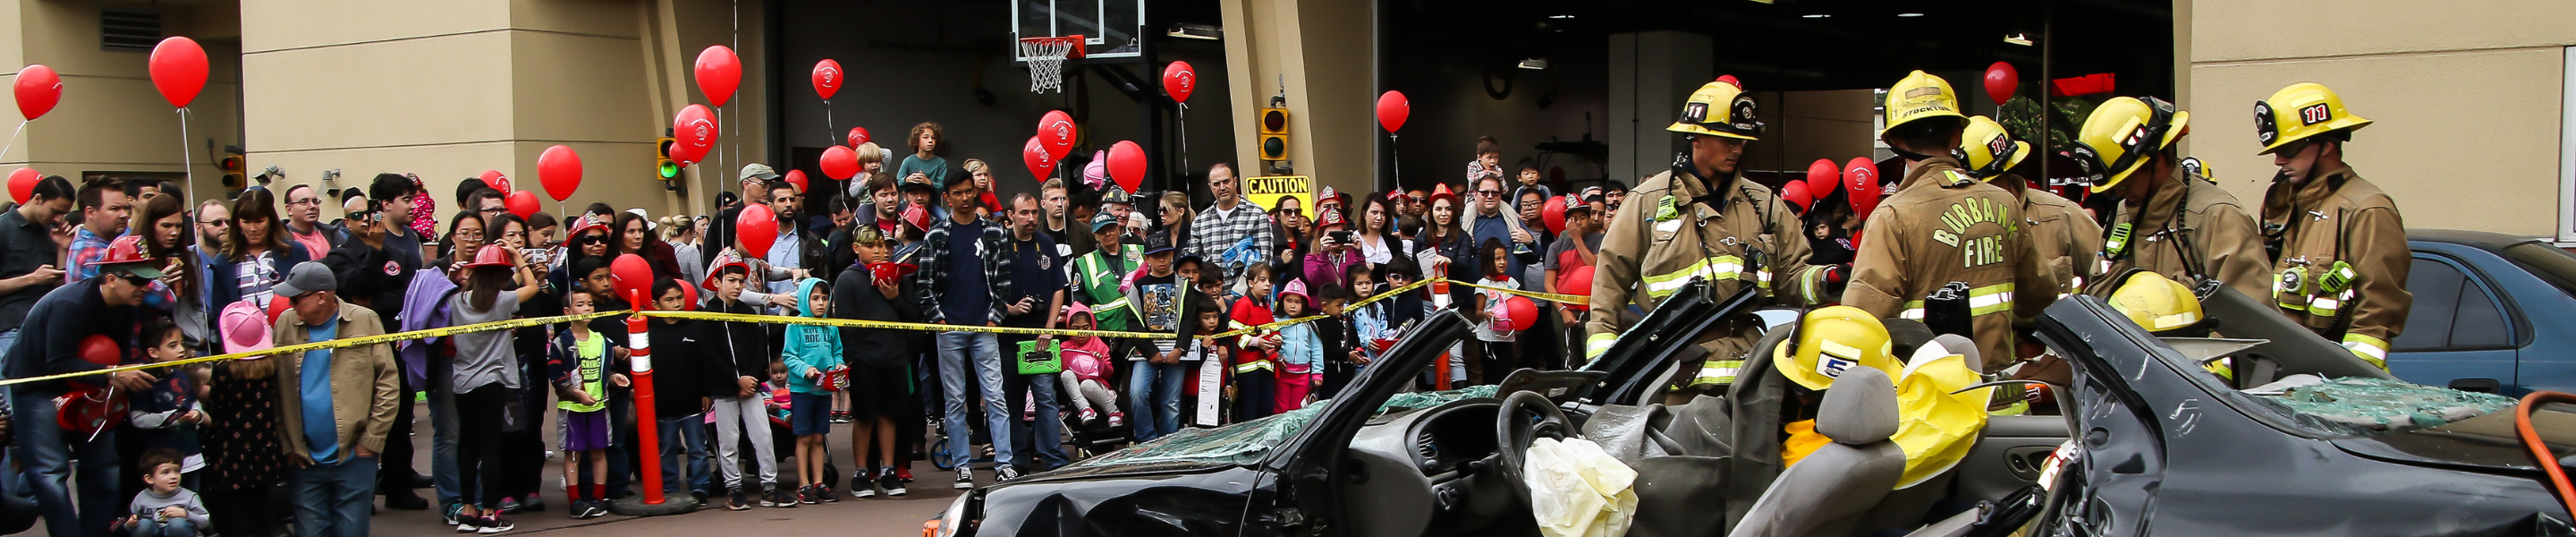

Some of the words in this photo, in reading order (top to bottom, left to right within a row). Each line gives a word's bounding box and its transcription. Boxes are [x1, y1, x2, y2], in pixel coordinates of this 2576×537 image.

[1688, 105, 1703, 119] 11
[1902, 106, 1952, 118] STOCKTON
[2304, 105, 2327, 124] 11
[1991, 135, 2006, 156] 11
[1249, 178, 1308, 193] CAUTION
[1095, 215, 1111, 223] CERT
[1933, 197, 2017, 248] BURBANK
[1964, 234, 2004, 268] FIRE
[1824, 359, 1848, 378] 5
